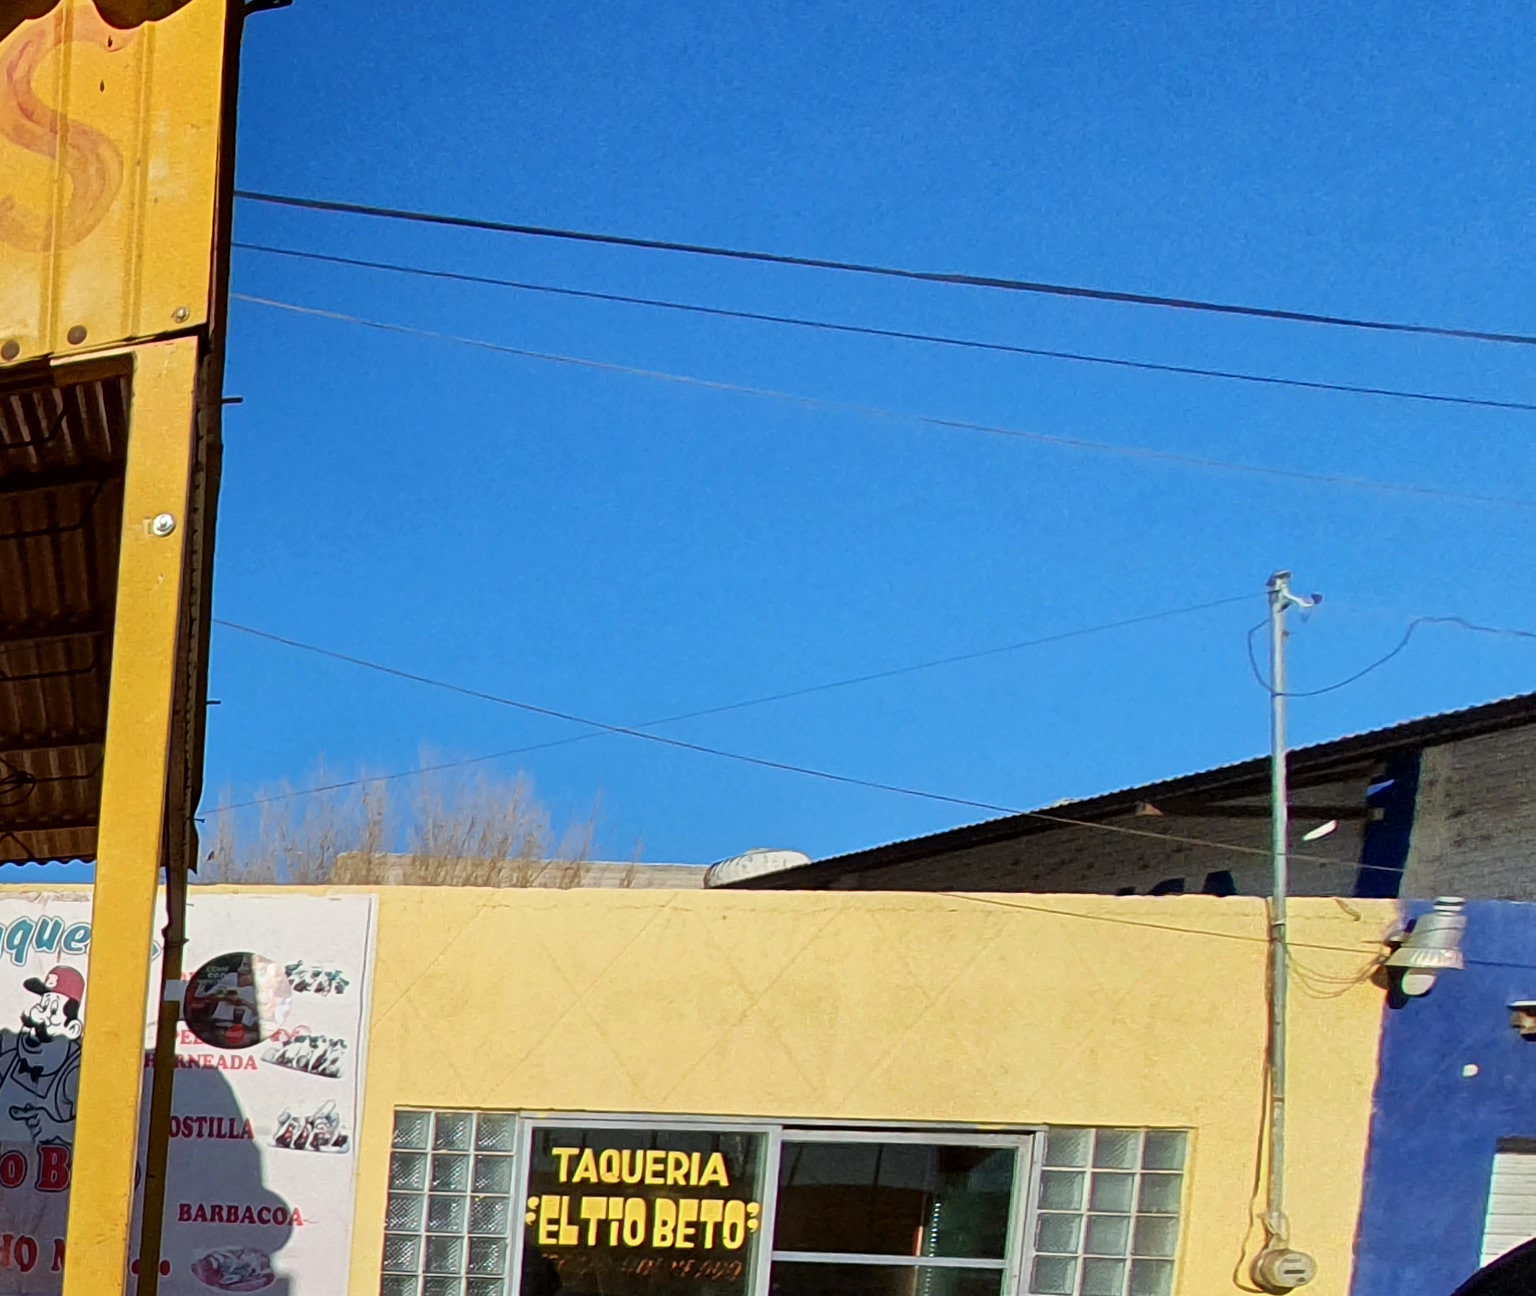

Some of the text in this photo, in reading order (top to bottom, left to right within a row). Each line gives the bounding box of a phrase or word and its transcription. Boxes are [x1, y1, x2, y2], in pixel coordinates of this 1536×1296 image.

[169, 1115, 255, 1140] OSTILLA
[551, 1146, 730, 1188] TAQUERIA
[177, 1202, 304, 1227] BARBACOA
